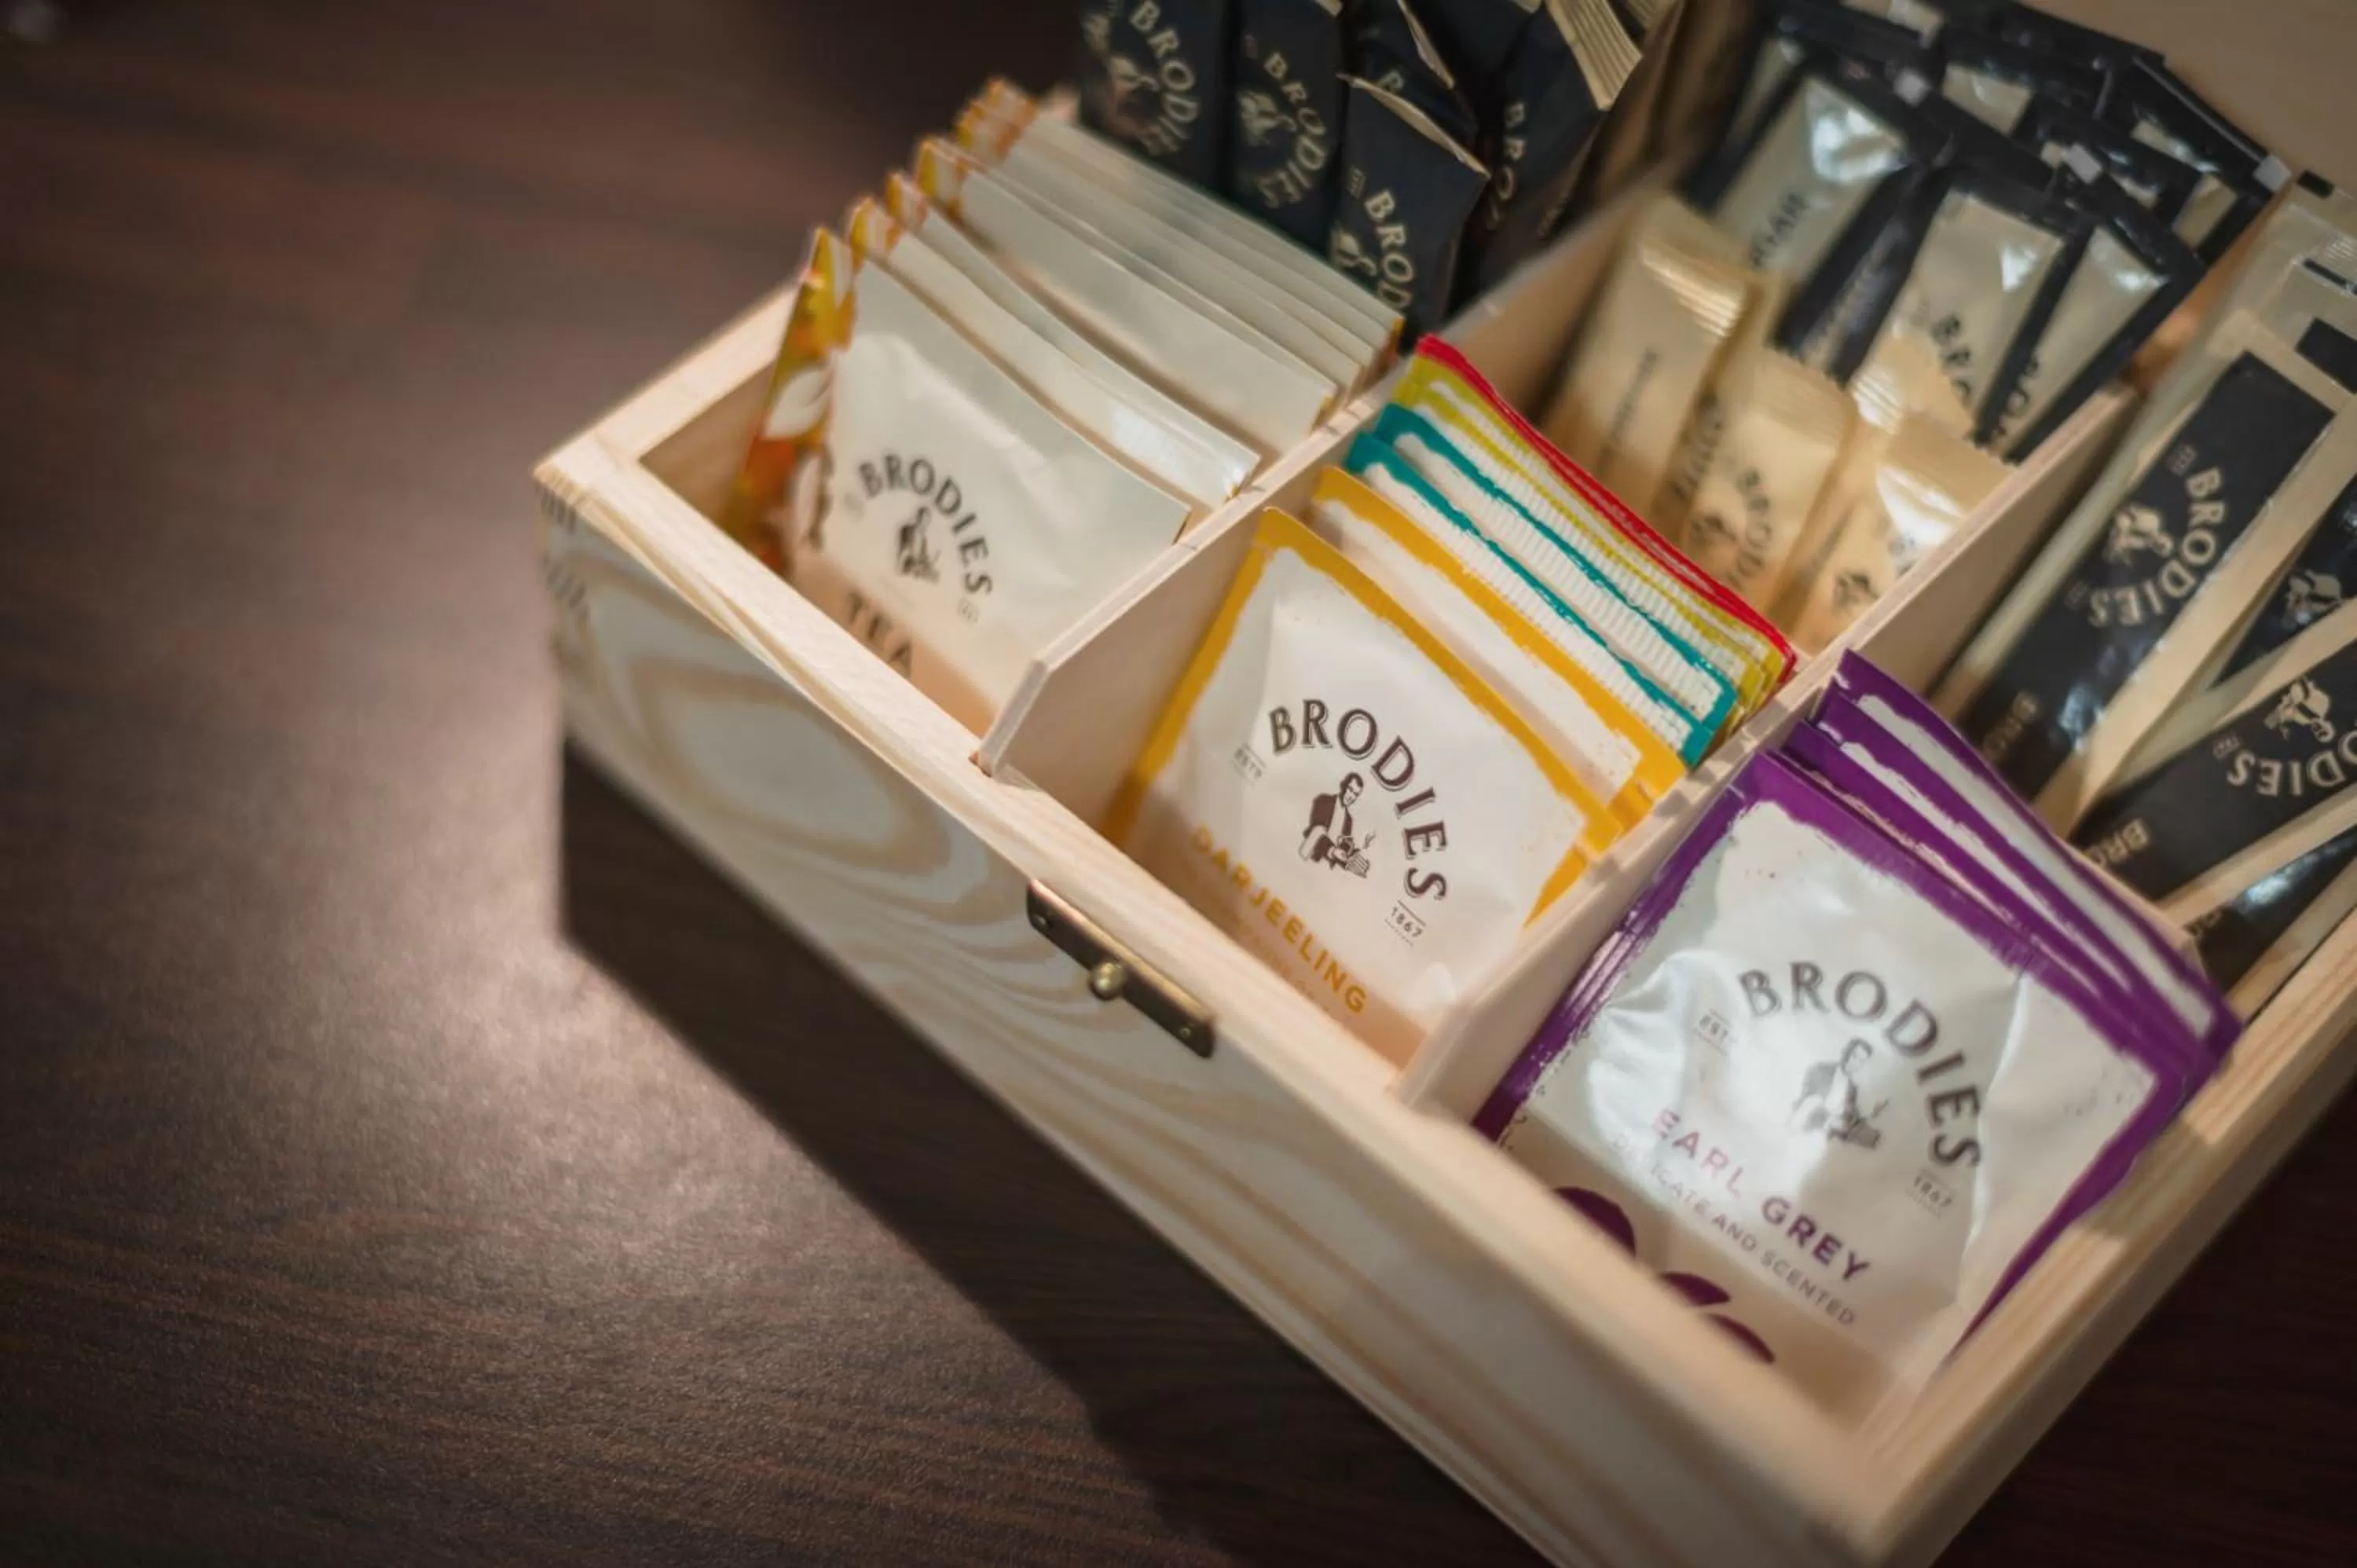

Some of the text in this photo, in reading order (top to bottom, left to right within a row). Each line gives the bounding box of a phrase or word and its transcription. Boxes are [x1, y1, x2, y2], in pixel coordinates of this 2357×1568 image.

[860, 452, 993, 595] BRODIES
[2088, 467, 2226, 627] BRODIES
[848, 591, 912, 678] TEA
[1268, 699, 1448, 901] BRODIES
[1188, 822, 1367, 1014] DARJEELING
[1390, 906, 1424, 937] 1867
[1738, 960, 1981, 1170] BRODIES
[1652, 1108, 1871, 1280] EARL GREY
[1712, 1213, 1758, 1252] AND
[1761, 1248, 1855, 1325] SCENTED
